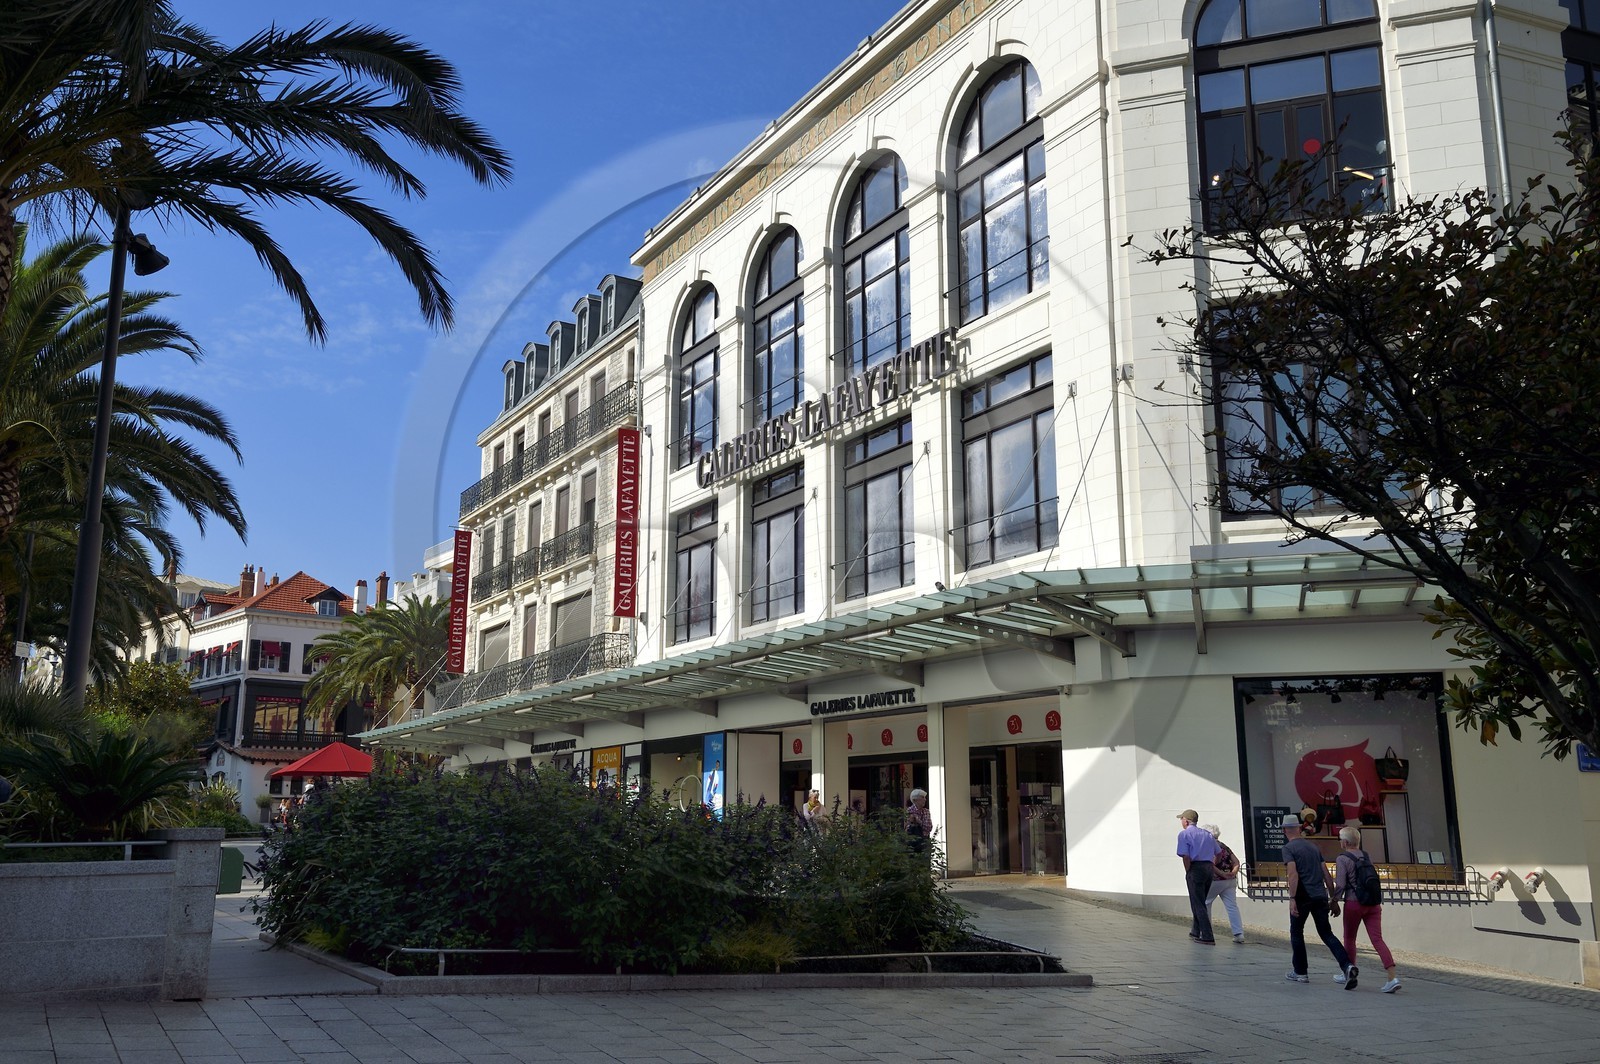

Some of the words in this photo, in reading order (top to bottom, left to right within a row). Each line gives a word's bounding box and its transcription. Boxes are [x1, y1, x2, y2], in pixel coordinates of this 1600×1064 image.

[696, 408, 797, 489] GALERIES
[799, 326, 959, 442] LAFAYETTE
[621, 435, 635, 525] LAFAYETTE
[455, 535, 469, 604] LAFAYETTE
[619, 532, 633, 611] GALERIES
[451, 608, 465, 668] GALERIES
[810, 695, 856, 716] GALERIES
[857, 687, 916, 709] LAFAYETTE
[596, 752, 617, 763] ACQUA
